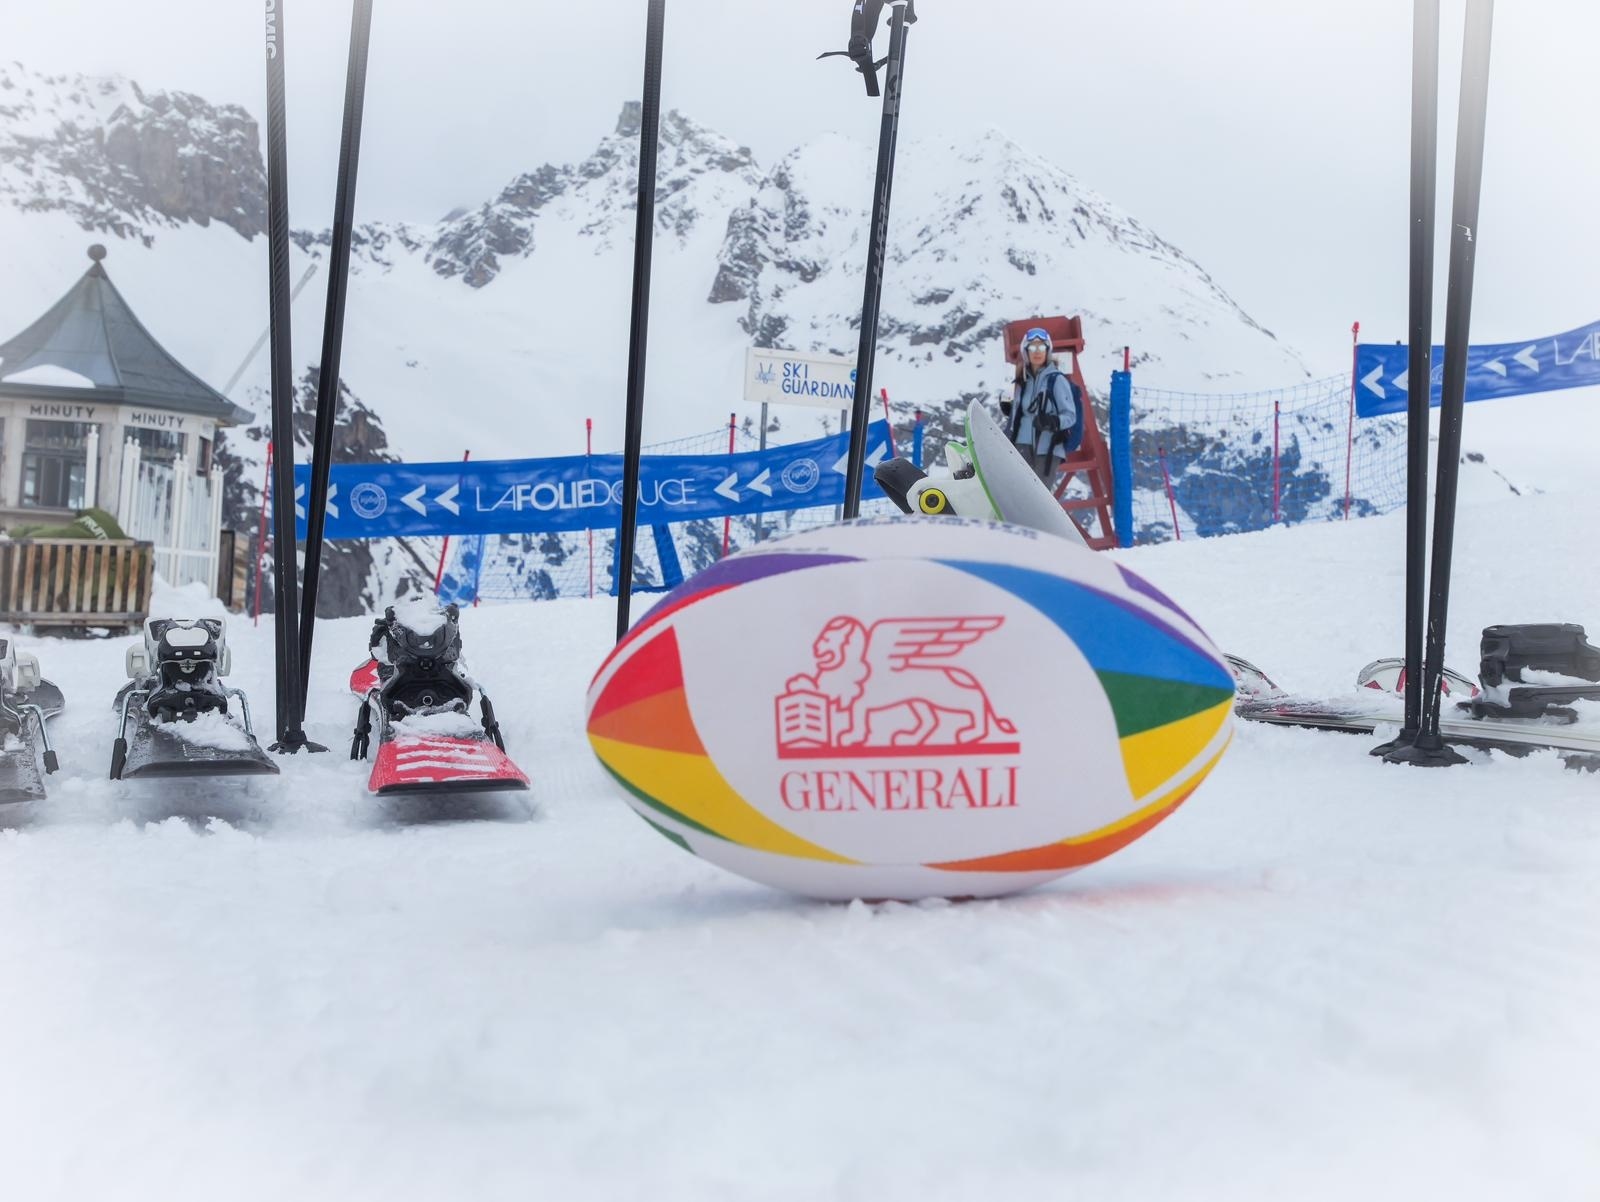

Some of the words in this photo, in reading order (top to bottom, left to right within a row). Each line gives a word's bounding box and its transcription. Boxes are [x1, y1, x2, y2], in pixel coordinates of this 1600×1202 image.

[782, 362, 808, 379] SKI
[781, 378, 854, 400] GUARDIAN
[30, 404, 96, 419] MINUTY
[131, 412, 185, 429] MINUTY
[779, 766, 1021, 812] GENERALI
